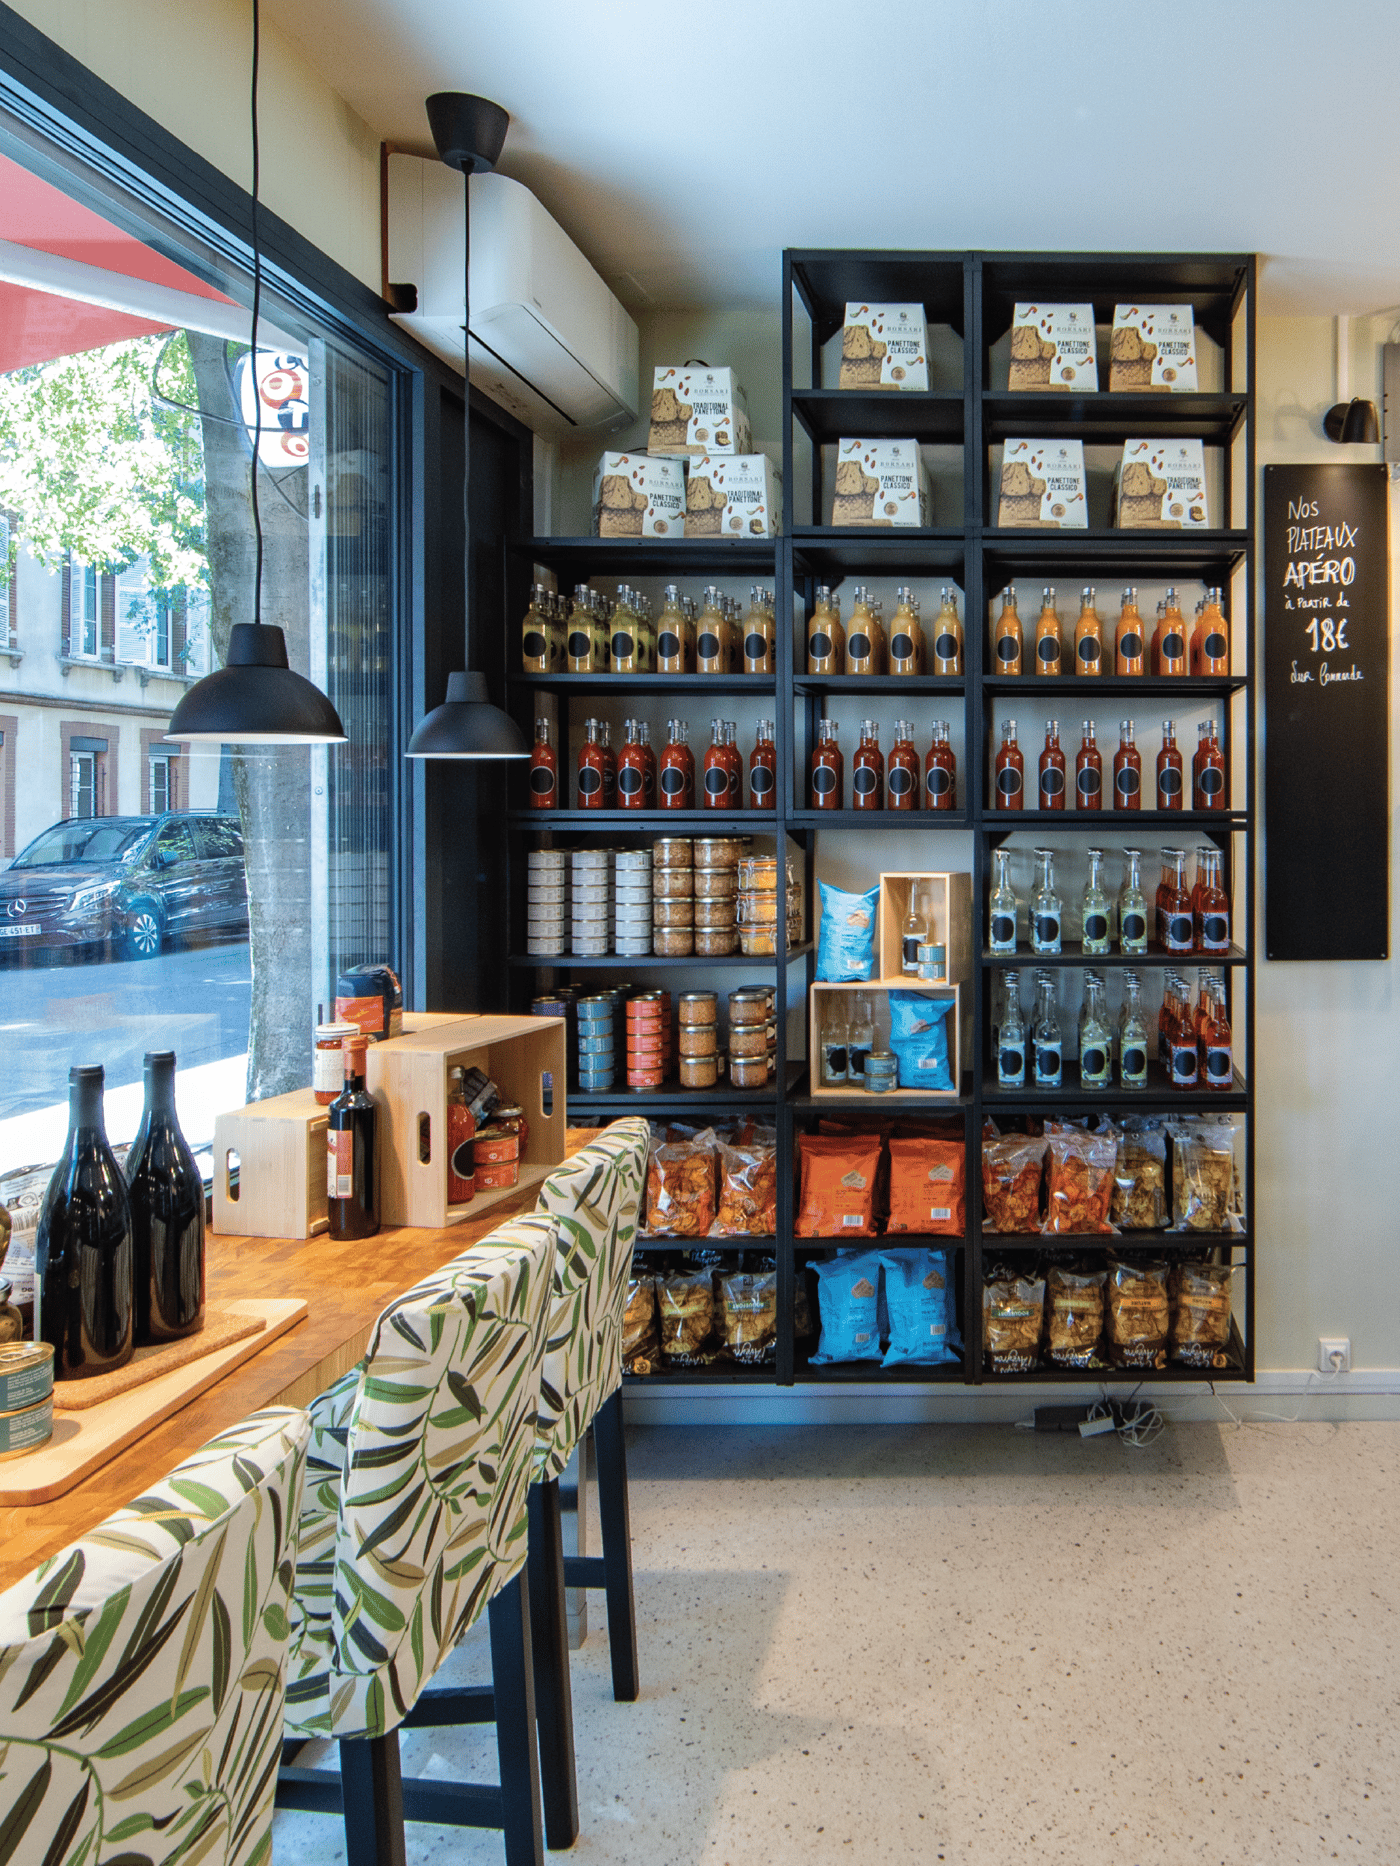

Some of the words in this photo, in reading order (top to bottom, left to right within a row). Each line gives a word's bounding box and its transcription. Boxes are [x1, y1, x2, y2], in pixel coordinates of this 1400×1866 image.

[887, 340, 921, 348] PANETTONE
[1057, 340, 1091, 348] PANETTONE
[1158, 341, 1191, 349] PANETTONE
[890, 347, 919, 355] CLASSICO
[1059, 347, 1088, 355] CLASSICO
[1160, 348, 1188, 356] CLASSICO
[693, 402, 729, 410] TRADITIONAL
[694, 408, 727, 416] PANETTONE
[880, 475, 913, 483] PANETTONE
[1047, 477, 1081, 485] PANETTONE
[1166, 476, 1202, 484] TRADITIONAL
[883, 482, 911, 490] CLASSICO
[1168, 482, 1200, 490] PANETTONE
[649, 493, 683, 503] PANETTONE
[727, 490, 764, 498] TRADITIONAL
[728, 496, 762, 504] PANETTONE
[652, 500, 680, 509] CLASSICO
[1286, 521, 1359, 554] PLATEAUX
[1282, 553, 1356, 590] APÉRO
[1284, 594, 1295, 610] à
[1335, 591, 1351, 608] de
[1305, 617, 1350, 652] 18€
